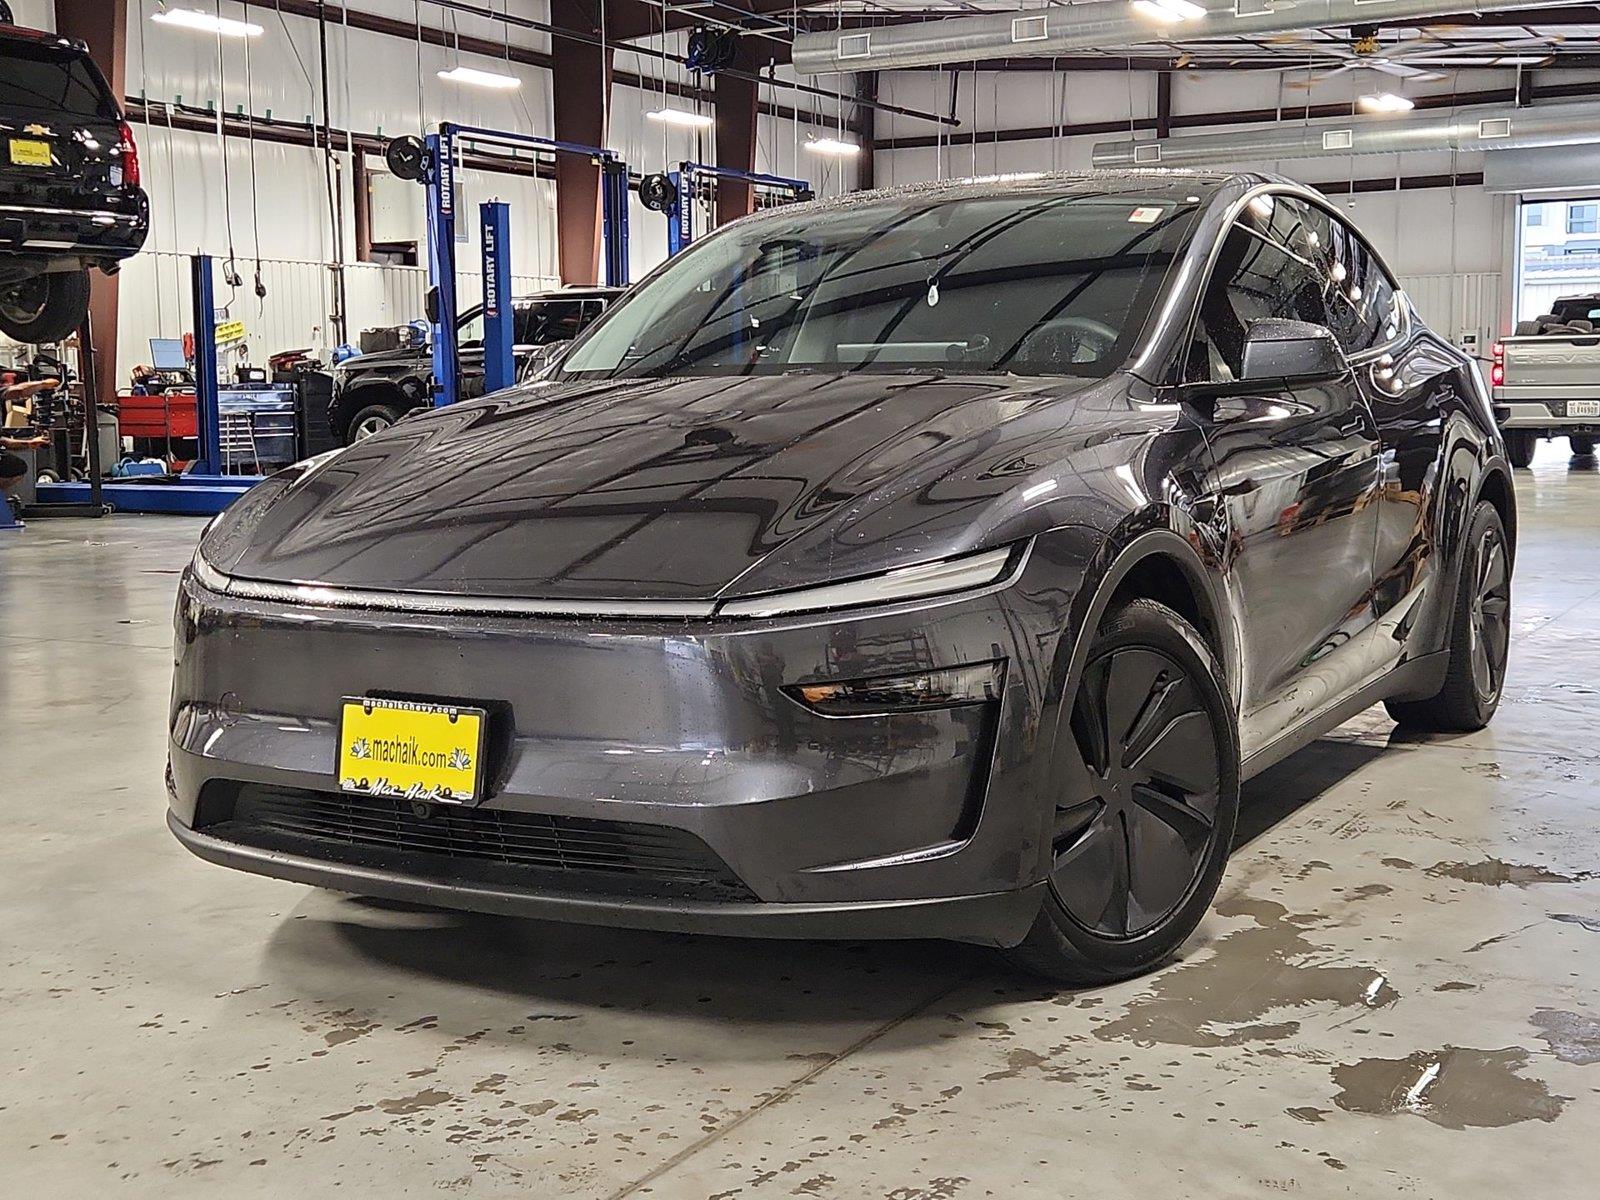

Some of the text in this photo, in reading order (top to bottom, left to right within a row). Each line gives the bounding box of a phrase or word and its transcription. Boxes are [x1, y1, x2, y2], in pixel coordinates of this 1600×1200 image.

[440, 136, 451, 208] ROTARY LIFT
[681, 172, 689, 234] ROTARY LIFT
[485, 224, 497, 308] ROTARY LIFT
[362, 699, 457, 714] machaikchevy.com
[372, 735, 447, 768] machaik.com
[368, 778, 457, 803] Mac Haik
